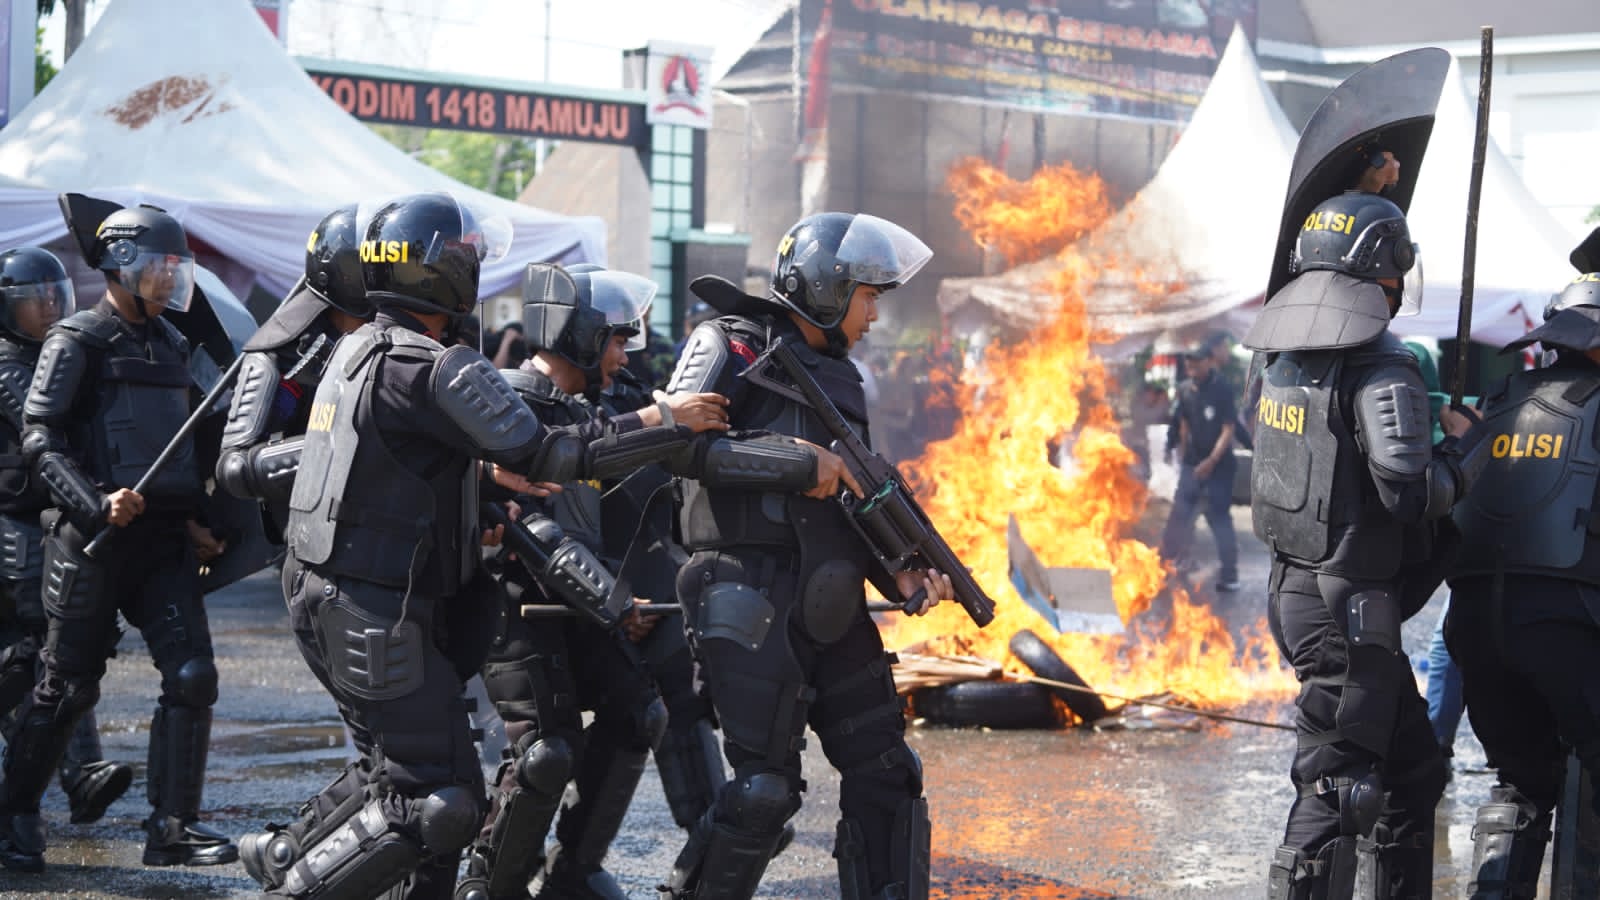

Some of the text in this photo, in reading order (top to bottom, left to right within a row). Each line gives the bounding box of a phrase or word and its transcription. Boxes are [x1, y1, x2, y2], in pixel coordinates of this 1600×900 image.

[1056, 16, 1217, 59] BERSAMA
[425, 87, 496, 128] 1418
[505, 95, 629, 140] MAMUJU
[1304, 211, 1356, 235] OLISI
[360, 240, 409, 263] OLISI
[1259, 396, 1304, 435] POLISI
[1492, 433, 1564, 459] OLISI
